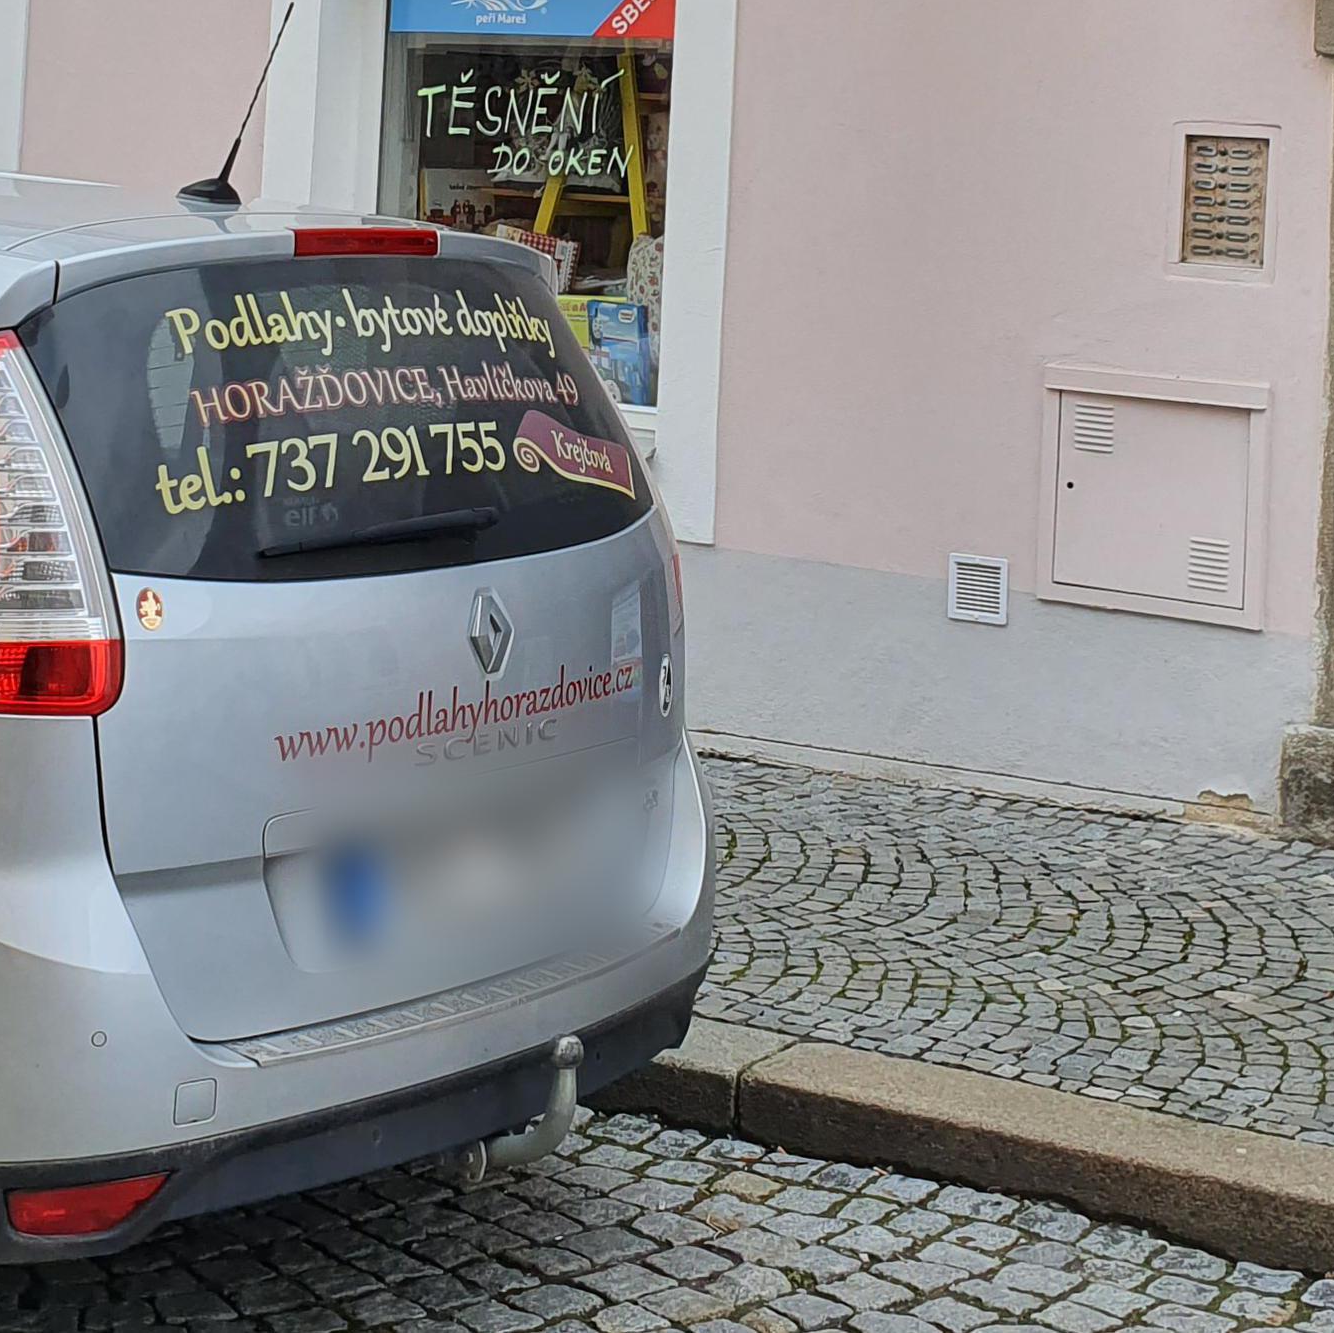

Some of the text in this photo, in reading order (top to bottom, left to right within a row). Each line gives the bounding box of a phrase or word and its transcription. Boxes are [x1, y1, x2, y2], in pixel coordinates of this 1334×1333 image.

[417, 68, 625, 138] TĚSNĚNÍ
[487, 144, 634, 178] DO OKEN
[165, 288, 556, 359] Podlahy bytové doplňky
[190, 361, 579, 428] HORAŽĎOVICE, Havlíčkova 49
[155, 420, 507, 515] tel.: 737 291 755
[550, 429, 614, 475] Krejčová
[274, 664, 635, 763] www.podlahyhorazdovice.cz
[414, 717, 558, 767] SCENIC
